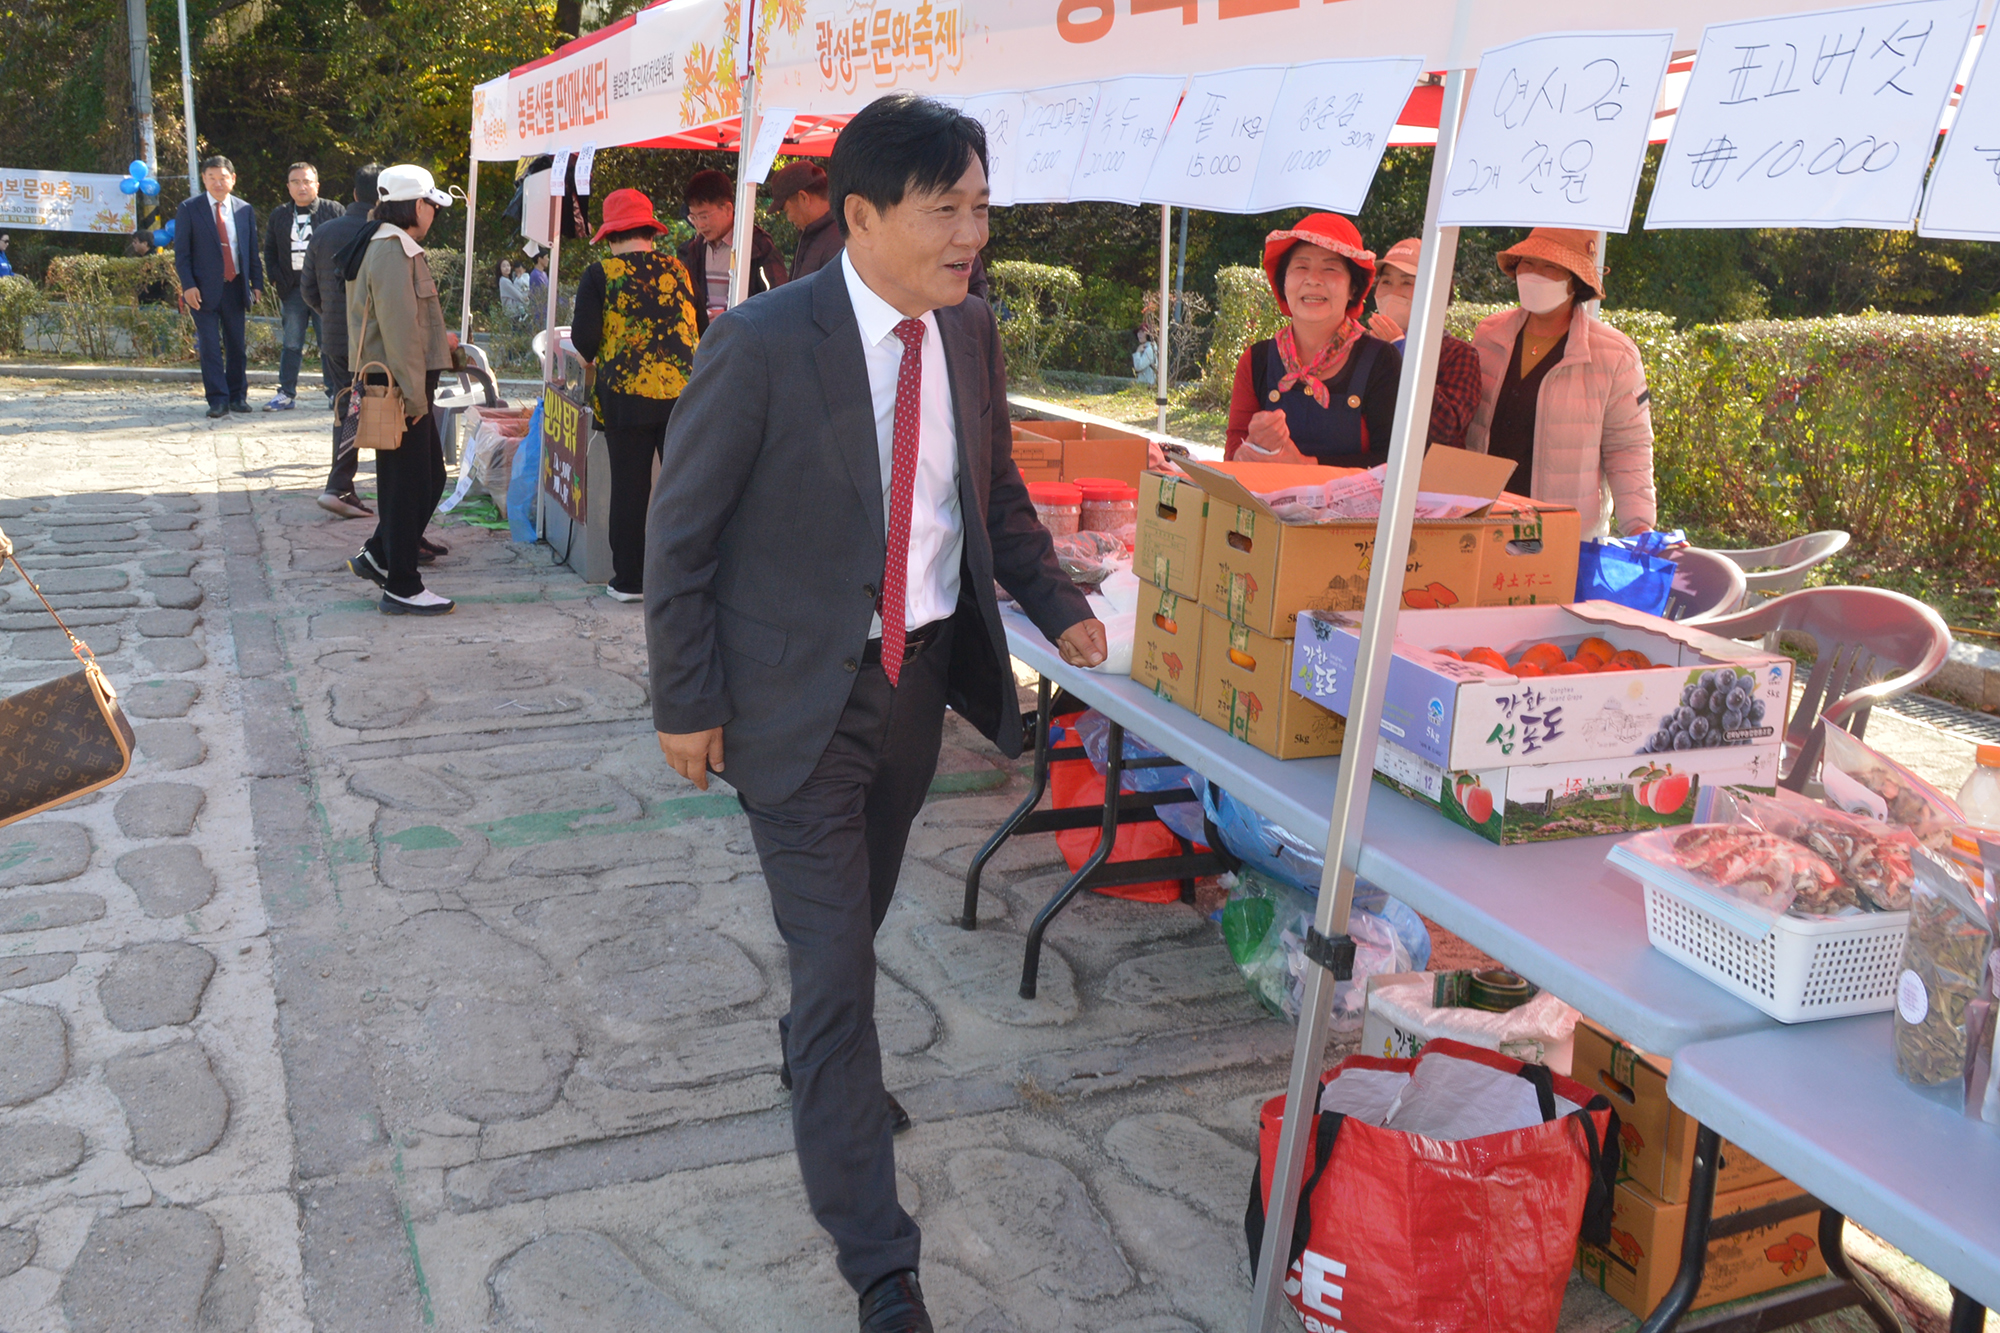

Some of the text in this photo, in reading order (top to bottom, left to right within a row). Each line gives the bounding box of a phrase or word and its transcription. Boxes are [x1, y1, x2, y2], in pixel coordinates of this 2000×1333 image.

[612, 51, 675, 100] 불은면 주민자치위원회
[1493, 58, 1630, 130] 연시감
[517, 79, 554, 140] 농특산물
[556, 57, 609, 132] 판매센터
[1452, 139, 1596, 204] 2개 천원
[1303, 644, 1329, 665] 강화
[1495, 685, 1546, 719] 강화
[1294, 734, 1310, 744] 5kg
[1426, 725, 1440, 744] 5kg
